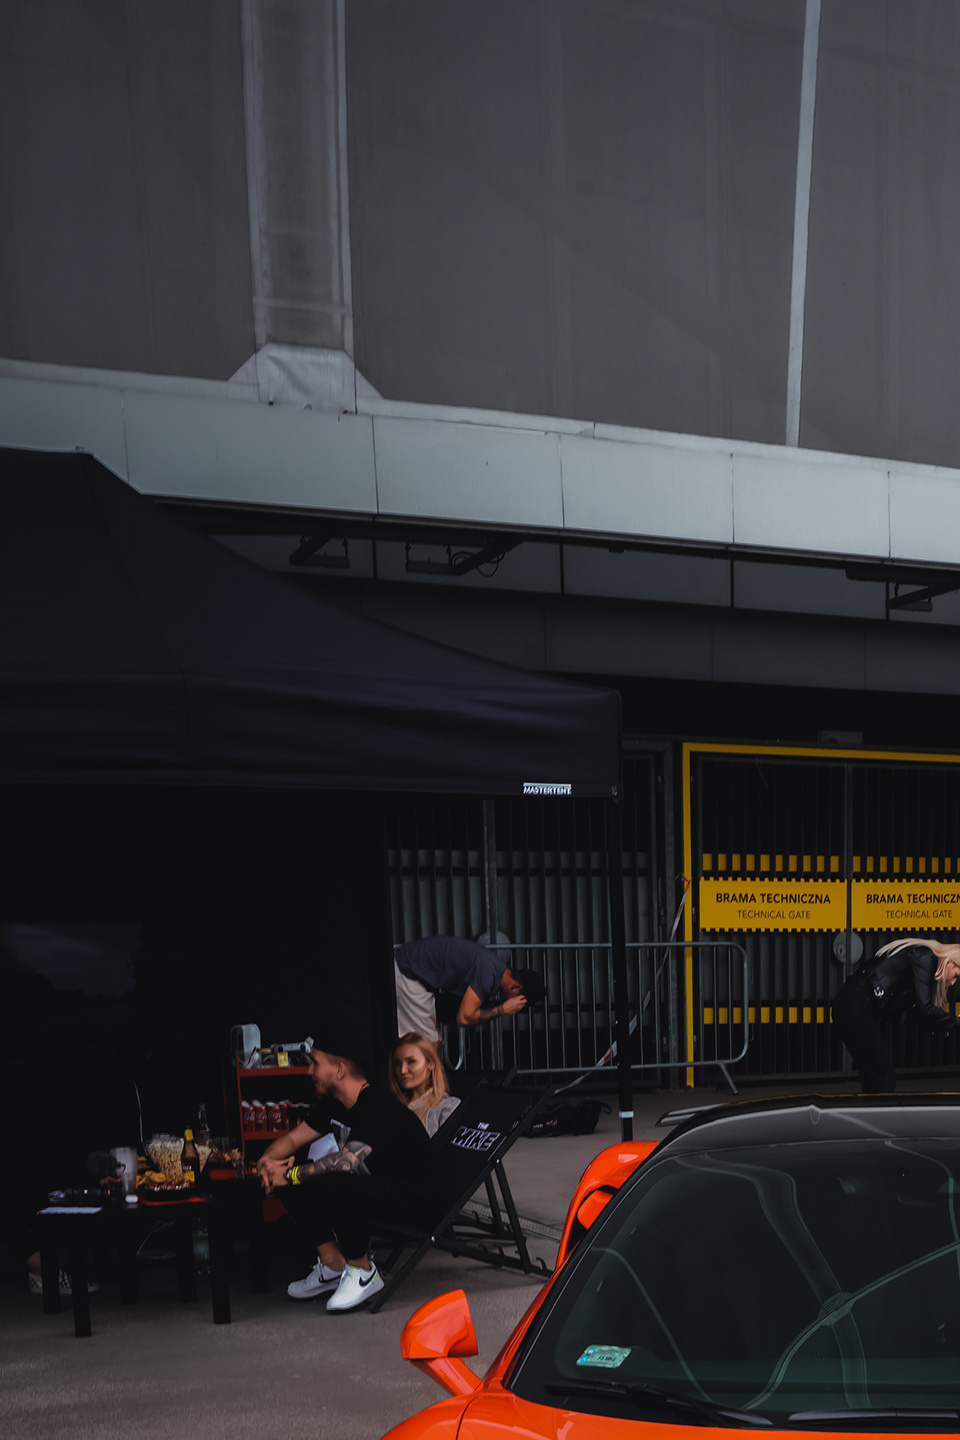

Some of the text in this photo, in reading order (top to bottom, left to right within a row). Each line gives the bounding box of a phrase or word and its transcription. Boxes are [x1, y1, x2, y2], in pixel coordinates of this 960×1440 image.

[716, 892, 832, 905] BRAMA TECHNICZNA
[866, 893, 904, 904] BRAMA
[737, 910, 811, 920] TECHNICAL GATE
[885, 909, 953, 919] TECHNICAL GATE
[451, 1125, 501, 1152] MIKE
